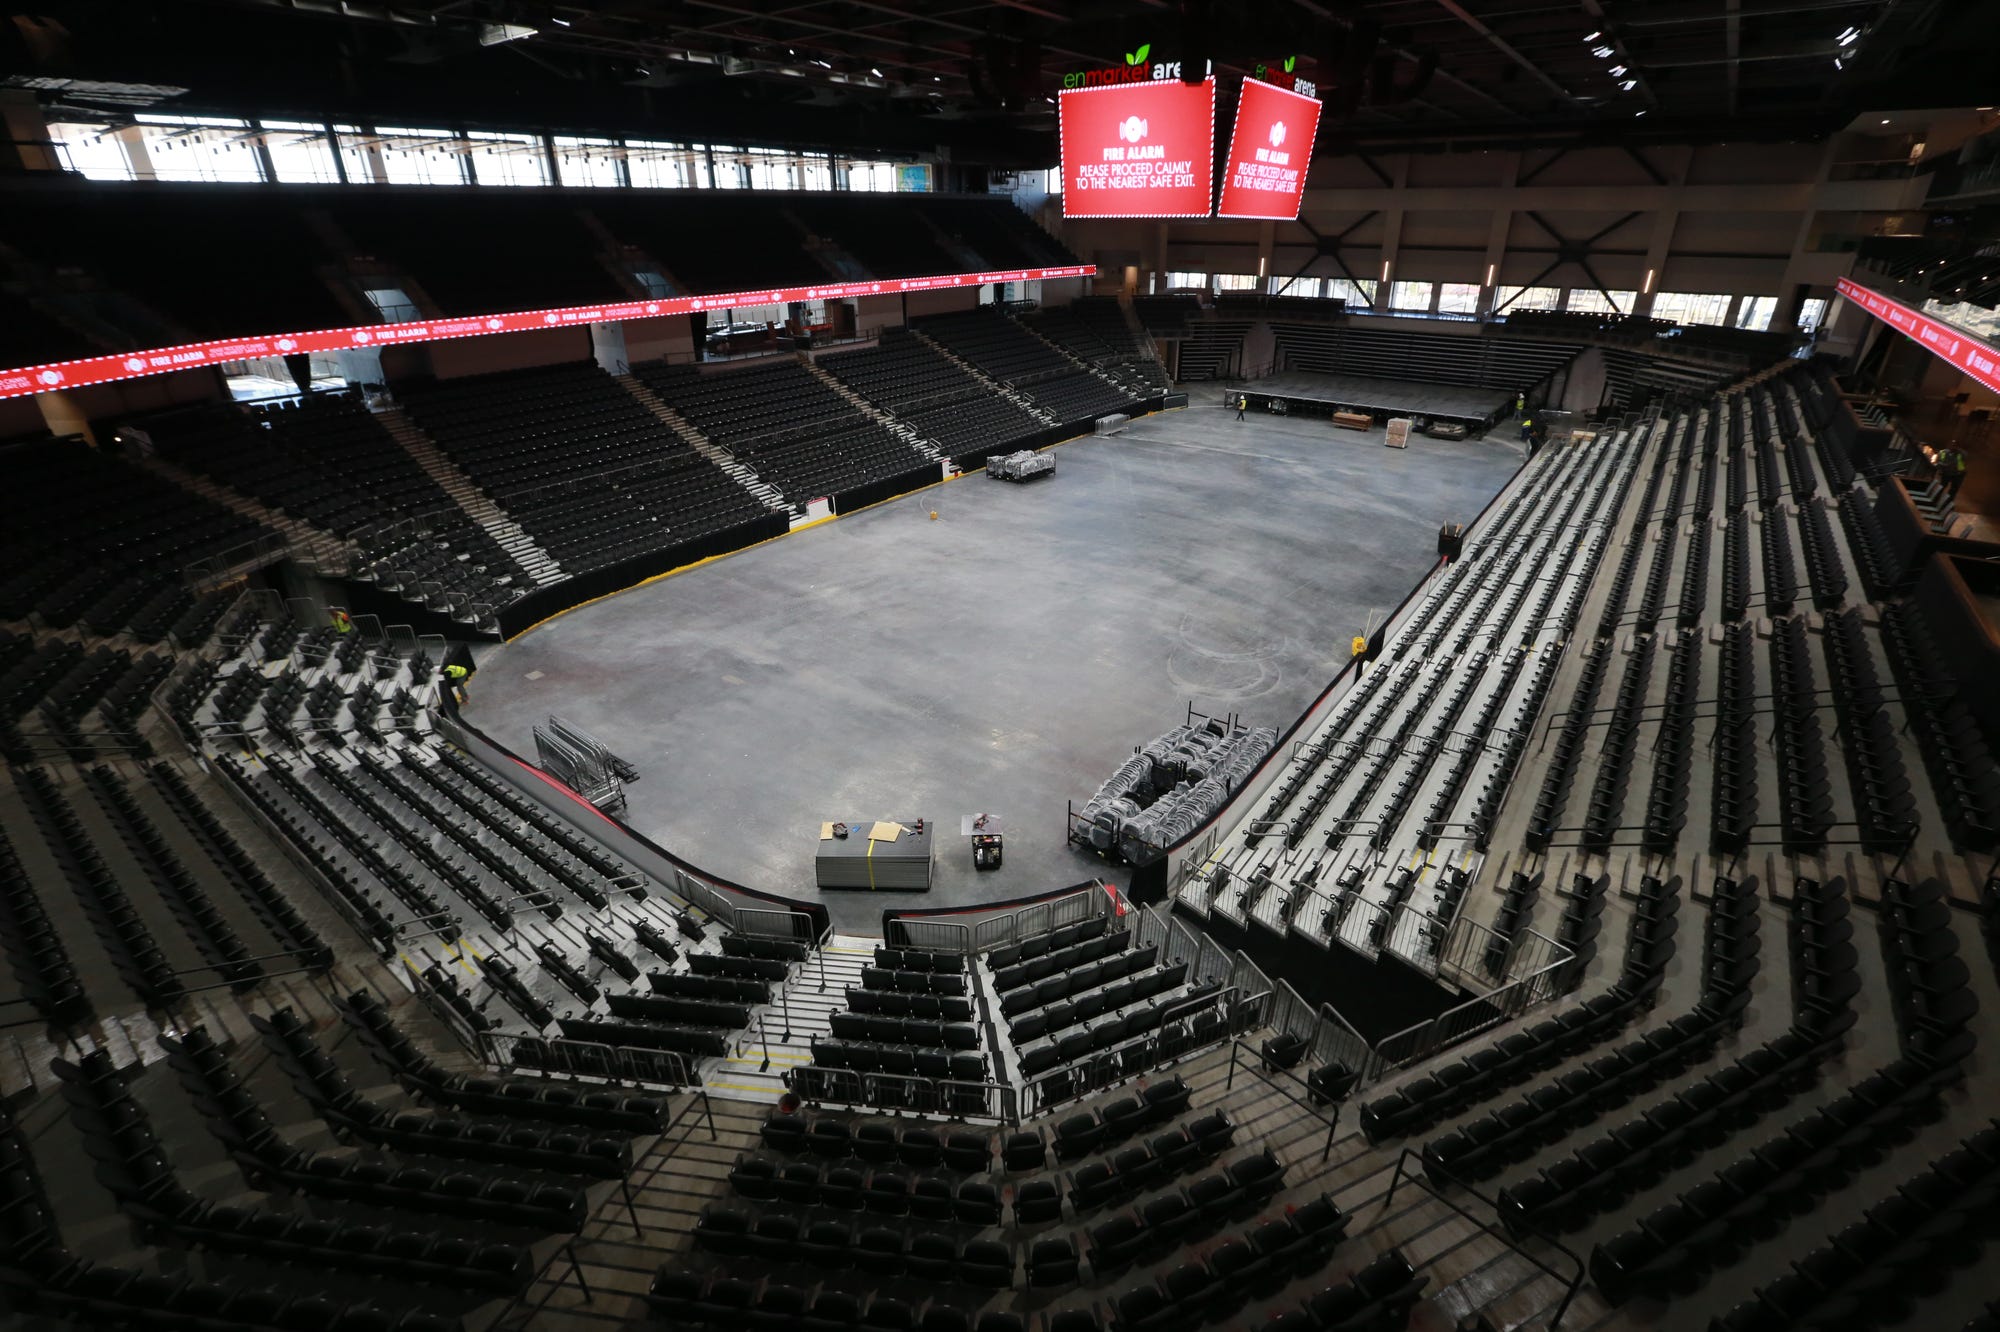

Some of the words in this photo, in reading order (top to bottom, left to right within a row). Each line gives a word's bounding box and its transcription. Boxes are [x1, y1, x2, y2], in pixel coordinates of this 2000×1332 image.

[1064, 60, 1149, 88] enmarket
[1294, 77, 1316, 98] arena
[1103, 147, 1125, 160] FIRE
[1127, 145, 1164, 160] ALARM
[1255, 147, 1270, 162] FIRE
[1269, 150, 1289, 165] ALARM
[1080, 164, 1109, 177] PLEASE
[1111, 162, 1153, 176] PROCEED
[1155, 161, 1192, 174] CALMLY
[1238, 162, 1257, 176] PLEASE
[1076, 178, 1088, 190] TO
[1090, 177, 1106, 189] THE
[1108, 175, 1147, 189] NEAREST
[1150, 175, 1172, 188] SAFE
[1174, 174, 1196, 187] EXIT.
[1233, 174, 1242, 188] TO
[1242, 176, 1253, 189] THE
[562, 313, 577, 321] FIRE
[578, 311, 602, 319] ALARM
[376, 330, 396, 340] FIRE
[397, 327, 428, 338] ALARM
[150, 356, 171, 367] FIRE
[173, 351, 205, 364] ALARM
